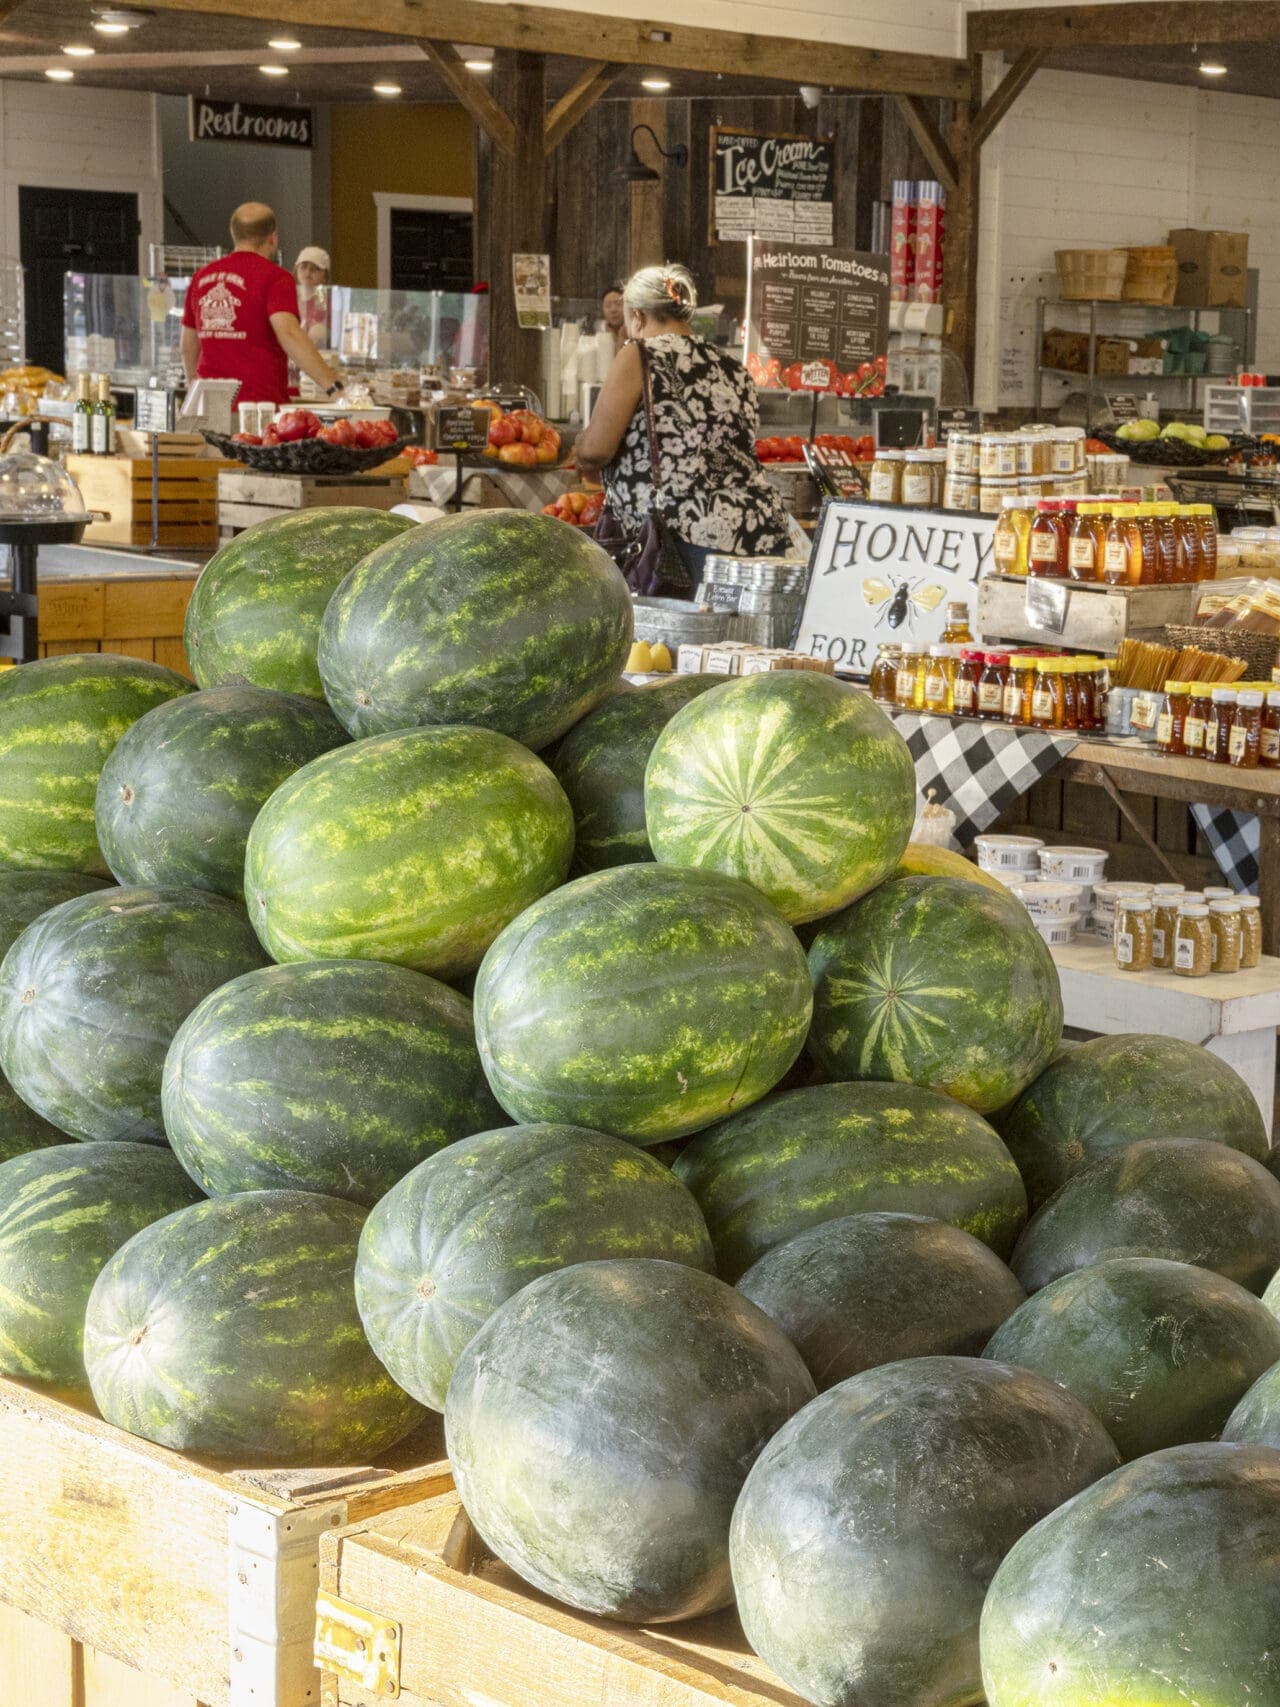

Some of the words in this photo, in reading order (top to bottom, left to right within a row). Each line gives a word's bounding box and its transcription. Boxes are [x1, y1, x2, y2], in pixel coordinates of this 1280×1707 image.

[198, 102, 308, 142] Restrooms
[716, 145, 762, 195] Ice
[760, 140, 824, 177] Cream
[762, 252, 817, 269] Heirloom
[820, 254, 880, 282] Tomatoes
[822, 516, 994, 583] HONEY
[810, 634, 866, 668] FOR
